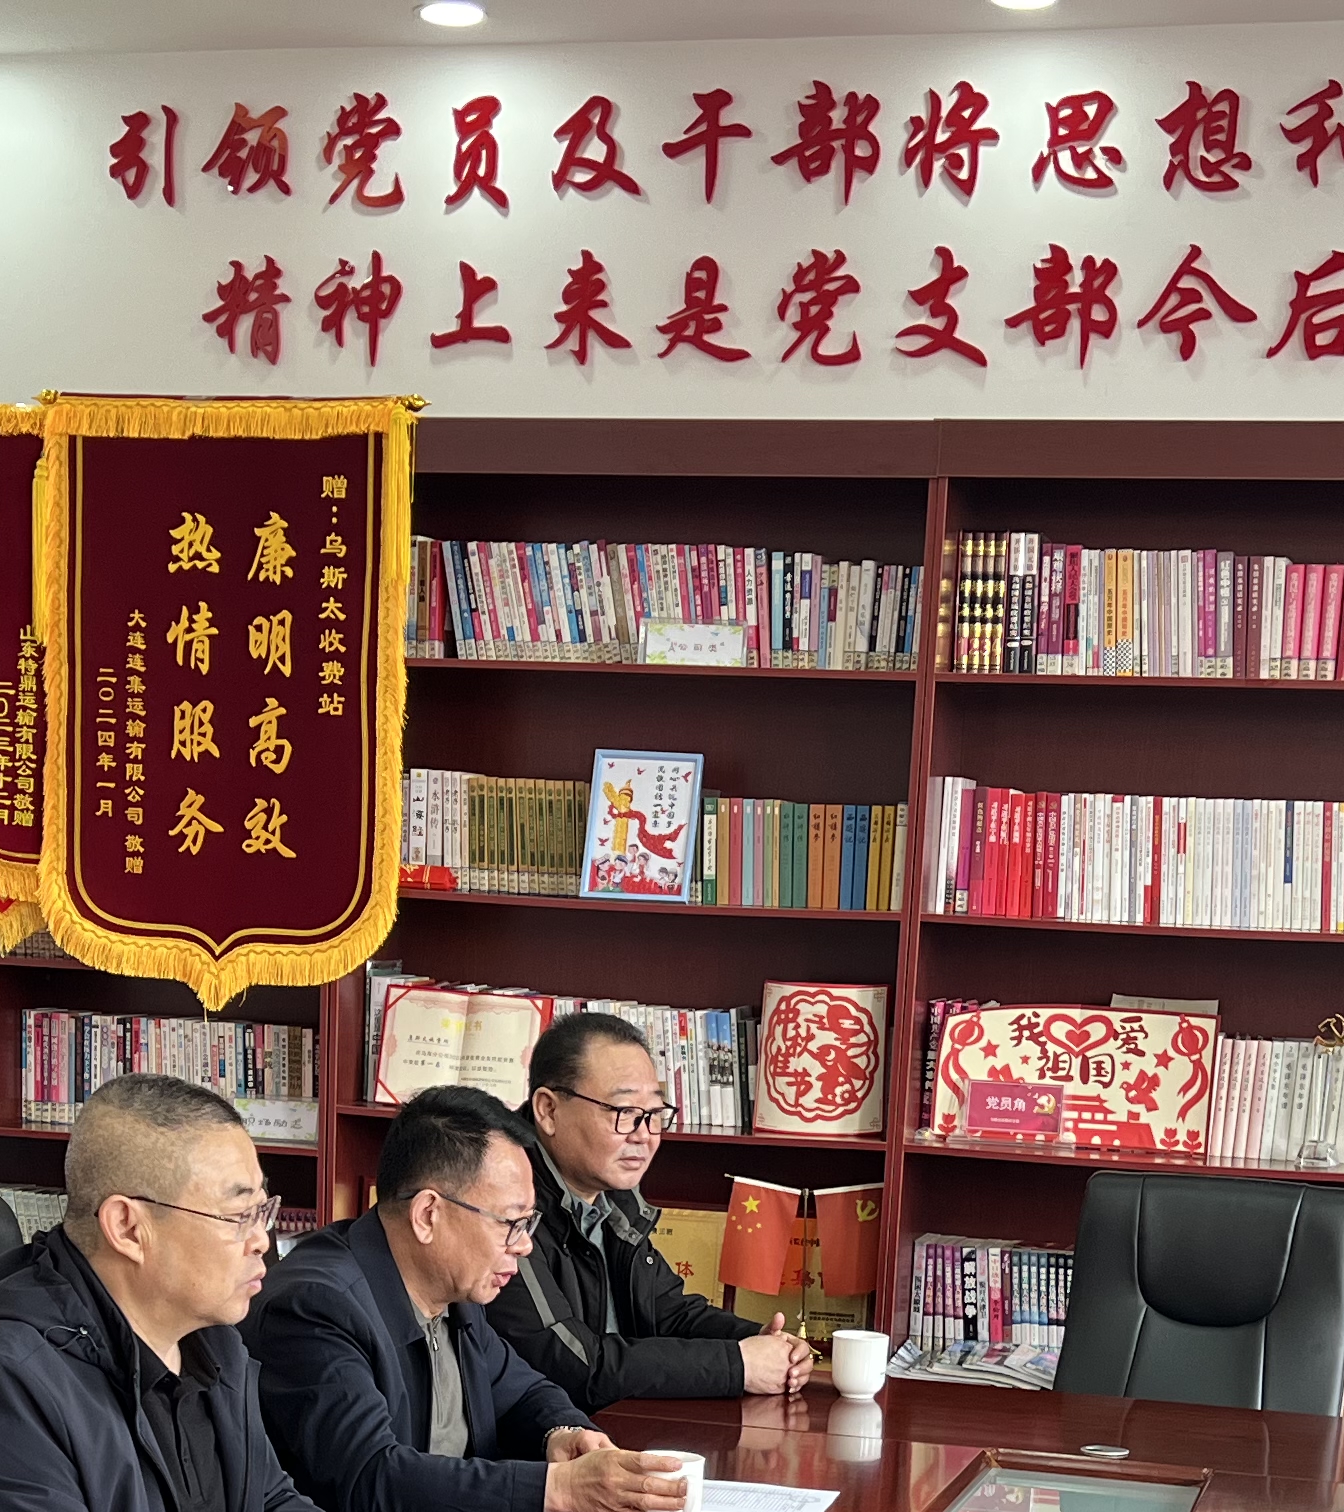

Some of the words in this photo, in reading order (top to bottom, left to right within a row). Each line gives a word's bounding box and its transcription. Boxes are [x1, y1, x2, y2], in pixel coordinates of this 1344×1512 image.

[317, 475, 348, 716] 赠：乌斯太收费站
[124, 609, 148, 826] 大连连集运输有限公司
[166, 511, 224, 856] 热情服务
[243, 511, 298, 859] 廉明高效
[123, 834, 146, 875] 敬赠
[1008, 1010, 1044, 1048] 我
[1112, 1015, 1149, 1057] 爱
[1034, 1045, 1117, 1090] 祖国
[985, 1095, 1027, 1112] 党员角
